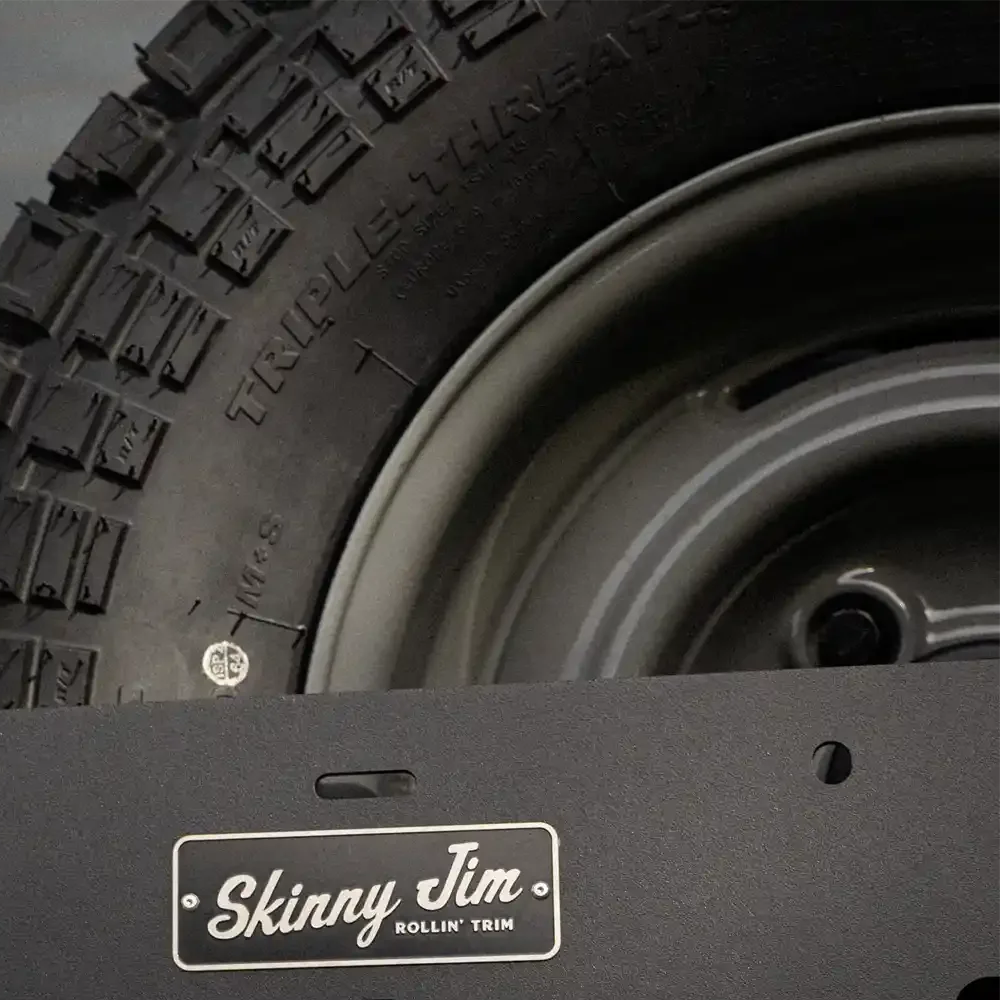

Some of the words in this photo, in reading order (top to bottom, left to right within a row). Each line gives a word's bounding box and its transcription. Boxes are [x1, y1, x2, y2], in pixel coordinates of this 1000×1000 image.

[207, 869, 402, 949] Skinny
[416, 841, 523, 911] Jim
[395, 919, 465, 935] ROLLIN'
[470, 918, 514, 933] TRIM
